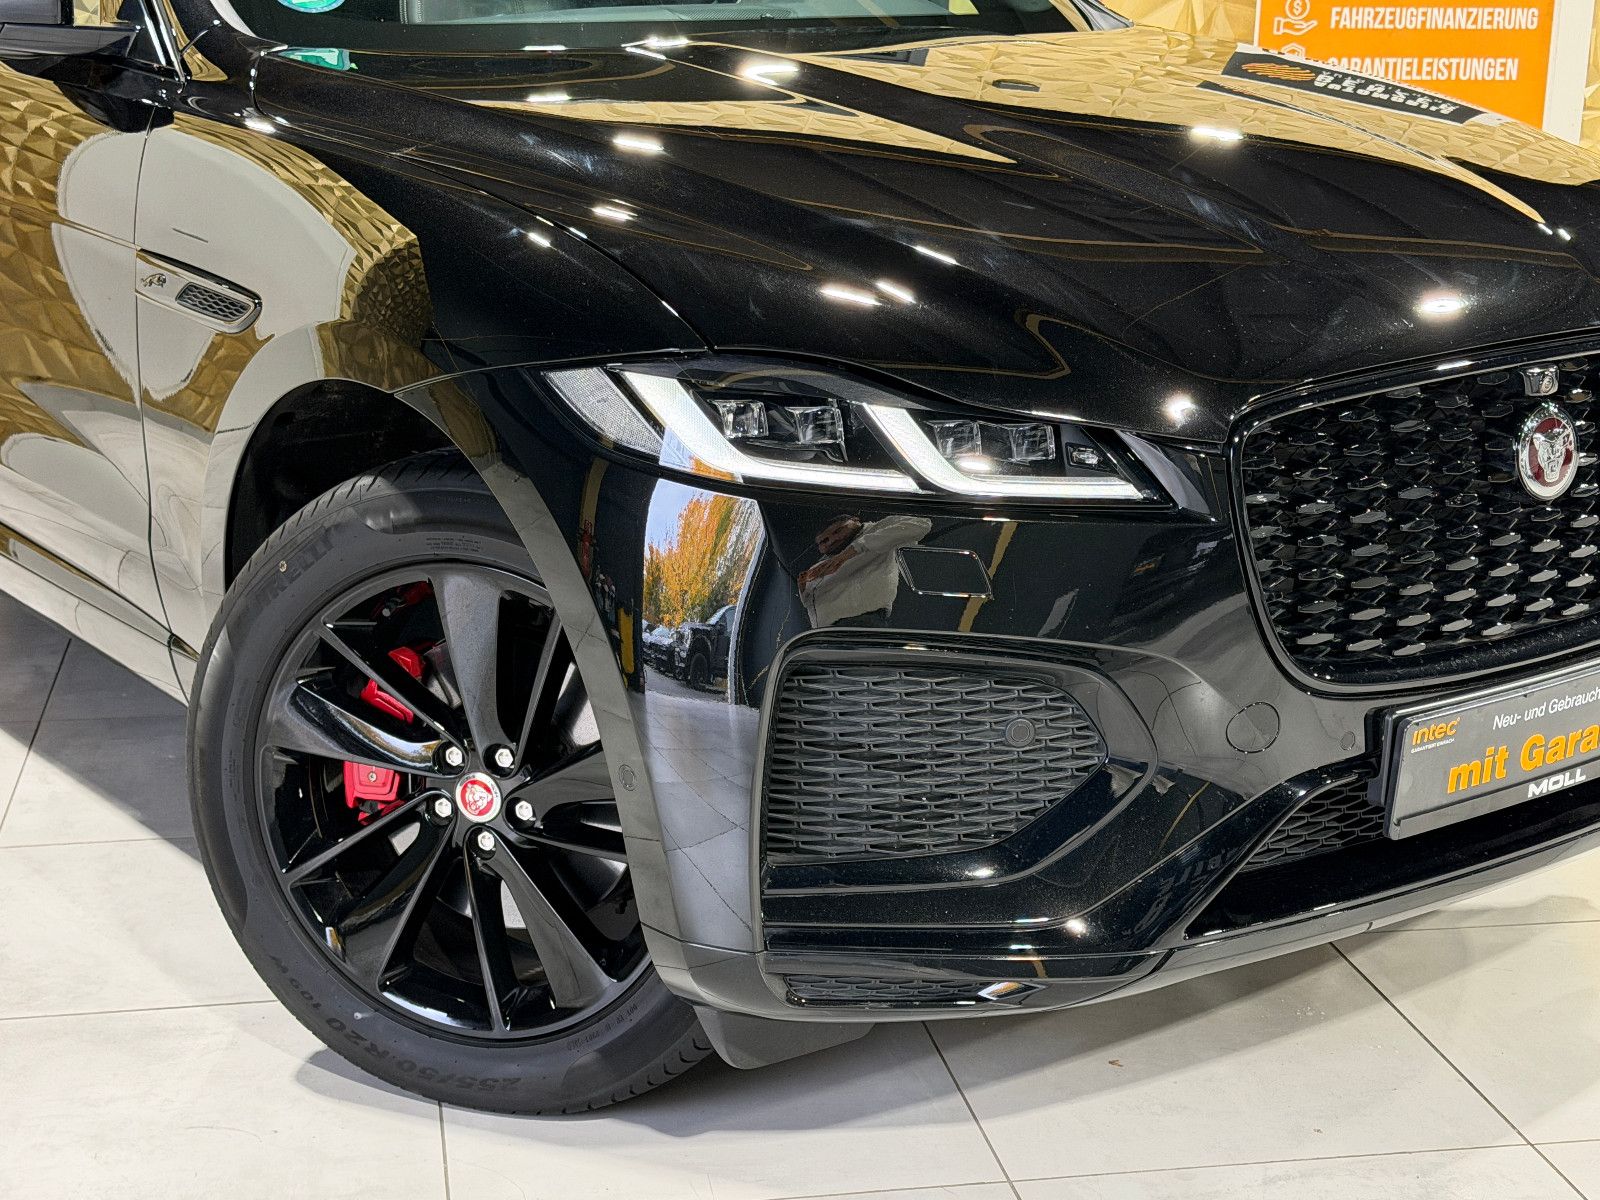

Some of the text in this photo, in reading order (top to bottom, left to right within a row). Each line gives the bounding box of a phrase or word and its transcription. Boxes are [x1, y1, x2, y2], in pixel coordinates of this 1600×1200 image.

[1330, 7, 1539, 30] FAHRZEUGFINANZIERUNG
[1493, 686, 1600, 730] Neu- und Gebrauch
[1448, 724, 1600, 794] mit Gara
[1527, 768, 1587, 798] MOLL
